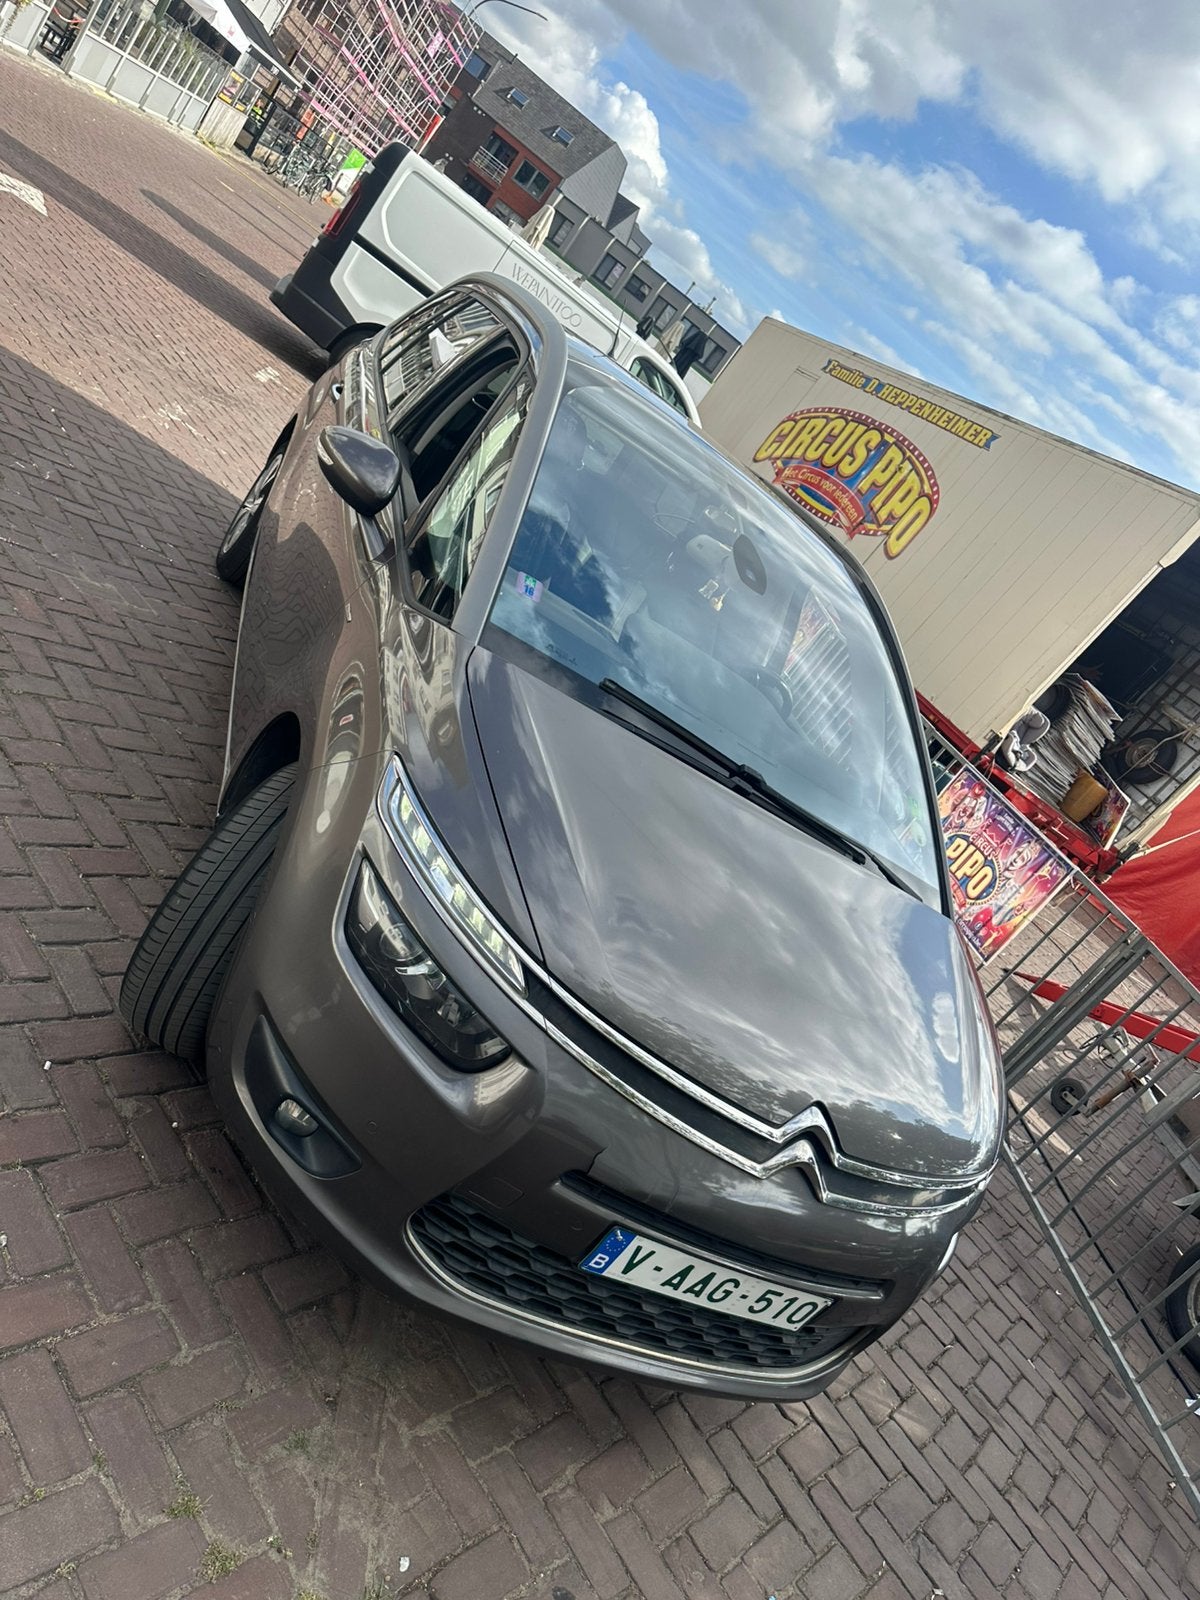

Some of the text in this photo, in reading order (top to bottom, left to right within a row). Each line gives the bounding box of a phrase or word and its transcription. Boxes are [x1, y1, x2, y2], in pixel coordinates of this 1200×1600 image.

[826, 360, 993, 448] Familie D. HEPPENHEIMER
[754, 416, 933, 559] CIRCUS PIPO
[781, 467, 798, 478] Het
[799, 469, 821, 483] Circus
[820, 477, 837, 494] voor
[946, 837, 993, 899] PIPO
[588, 1245, 819, 1325] B V-AAG-510
